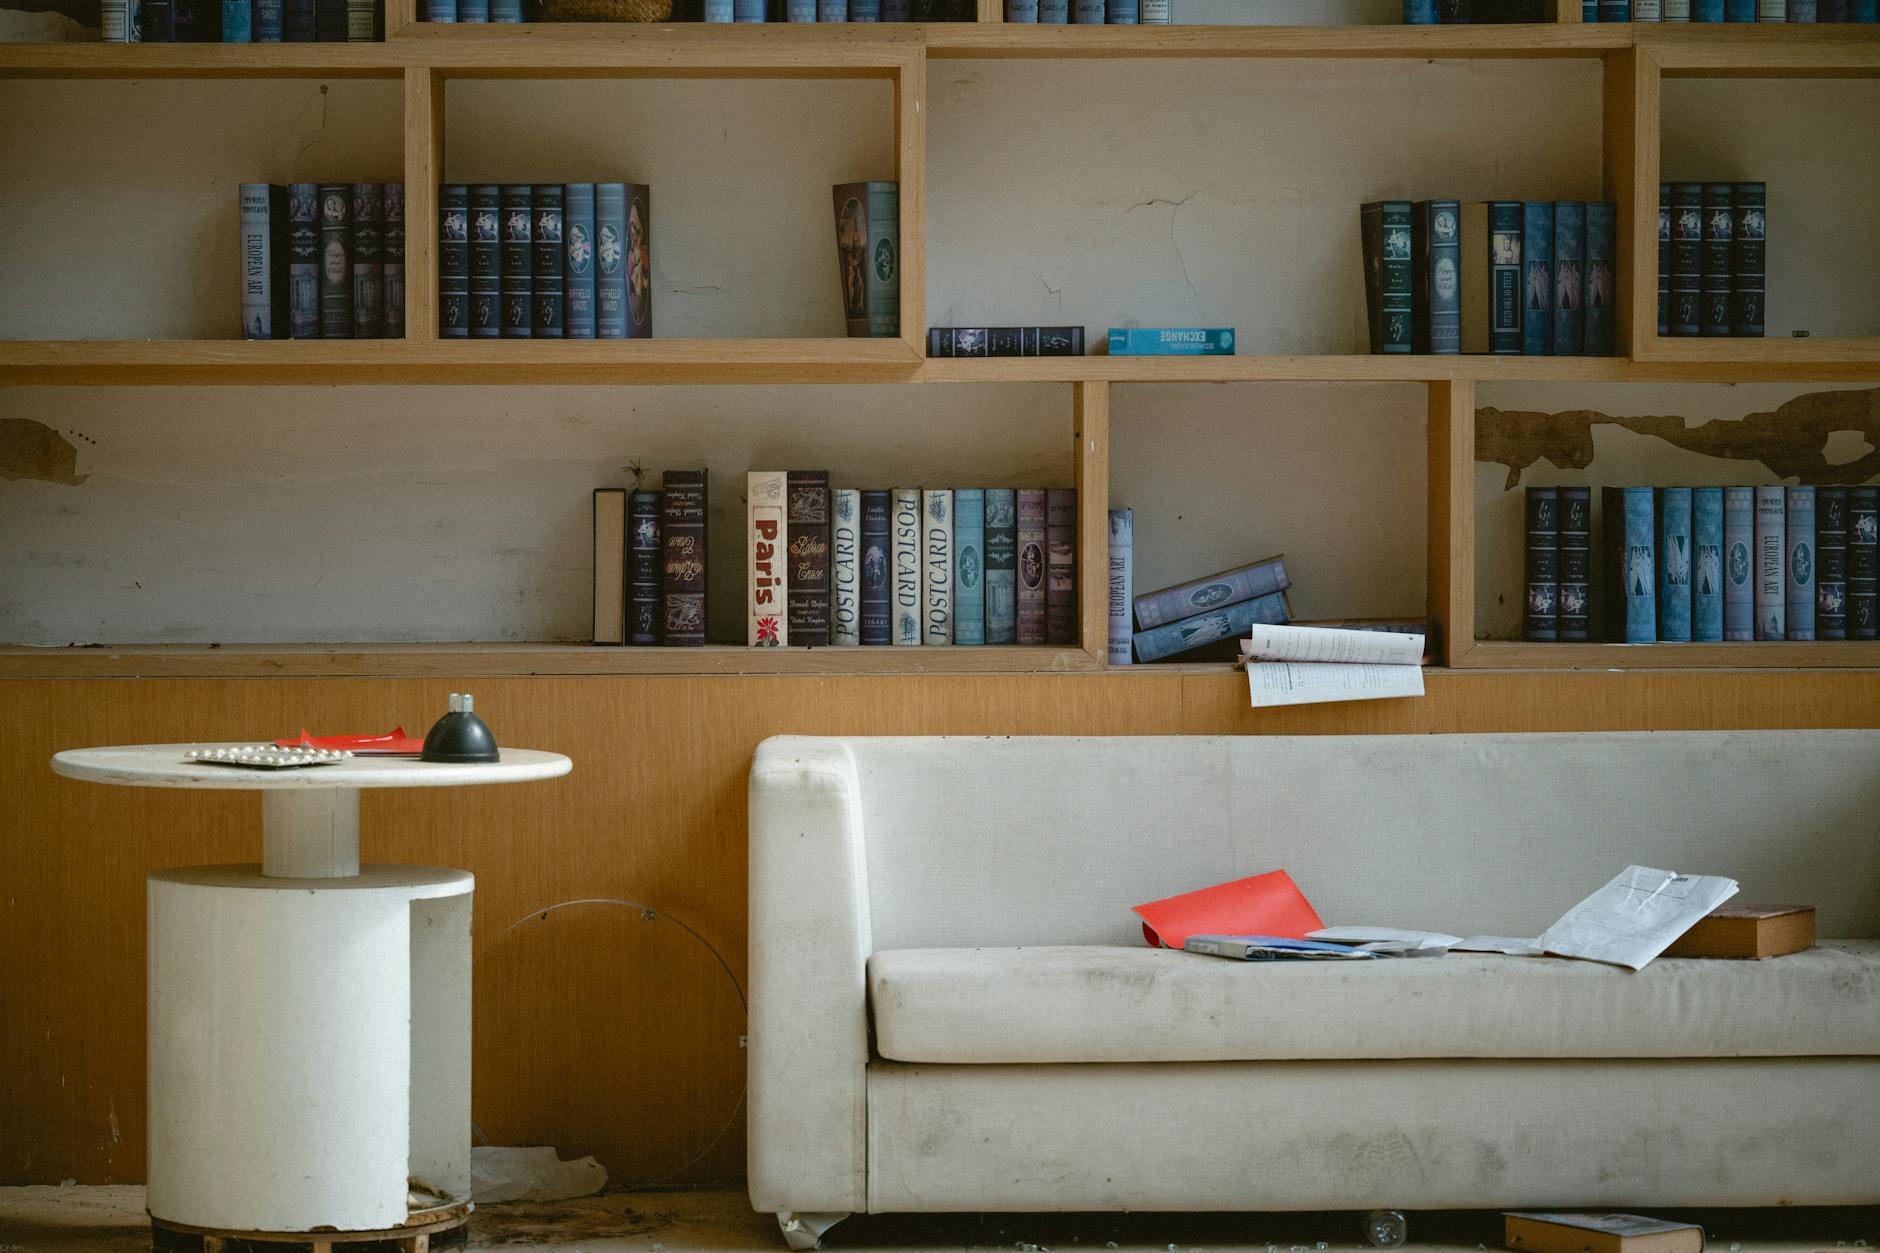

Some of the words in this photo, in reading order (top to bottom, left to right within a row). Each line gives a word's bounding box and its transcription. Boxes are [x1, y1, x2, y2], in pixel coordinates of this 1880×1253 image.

[247, 234, 263, 277] EUROPEAN
[247, 279, 263, 296] ART
[1159, 330, 1206, 342] EXCHANGE
[755, 520, 780, 605] Paris
[898, 498, 916, 608] POSTCARD
[1109, 556, 1125, 573] ART
[1763, 535, 1779, 577] EUROPEAN
[836, 527, 855, 637] POSTCARD
[929, 528, 948, 638] POSTCARD
[1109, 575, 1125, 617] EUROPEAN
[1763, 579, 1779, 595] ART
